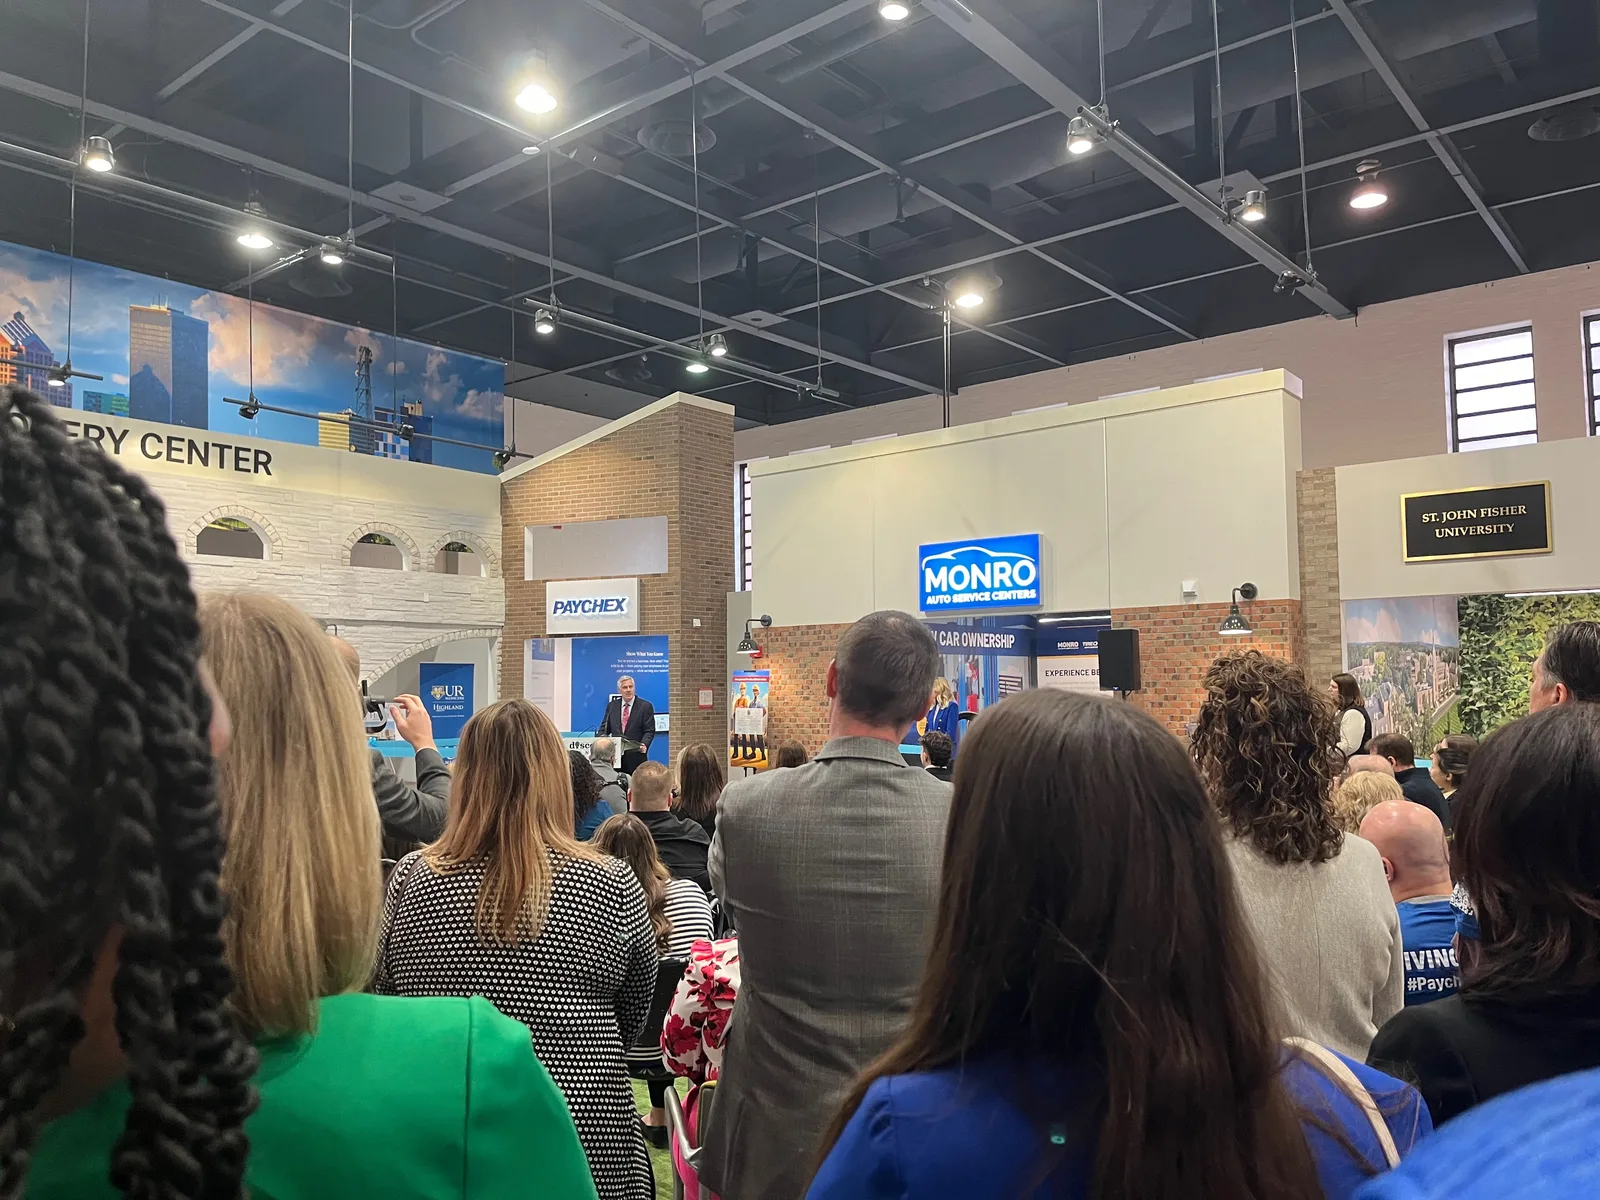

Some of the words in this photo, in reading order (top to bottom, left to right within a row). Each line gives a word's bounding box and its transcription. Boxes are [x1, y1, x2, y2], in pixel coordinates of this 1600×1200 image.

[140, 432, 273, 476] CENTER
[1421, 512, 1440, 523] ST.
[1442, 508, 1477, 523] JOHN
[1480, 504, 1527, 518] FISHER
[1434, 522, 1515, 539] UNIVERSITY
[925, 560, 1037, 593] MONRO
[553, 597, 628, 615] PAYCHEX
[926, 594, 951, 605] AUTO
[952, 592, 991, 604] SERVICE
[991, 589, 1037, 601] CENTERS
[939, 630, 960, 647] CAR
[961, 631, 1016, 649] OWNERSHIP
[1045, 669, 1089, 677] EXPERIENCE
[445, 685, 464, 697] UR
